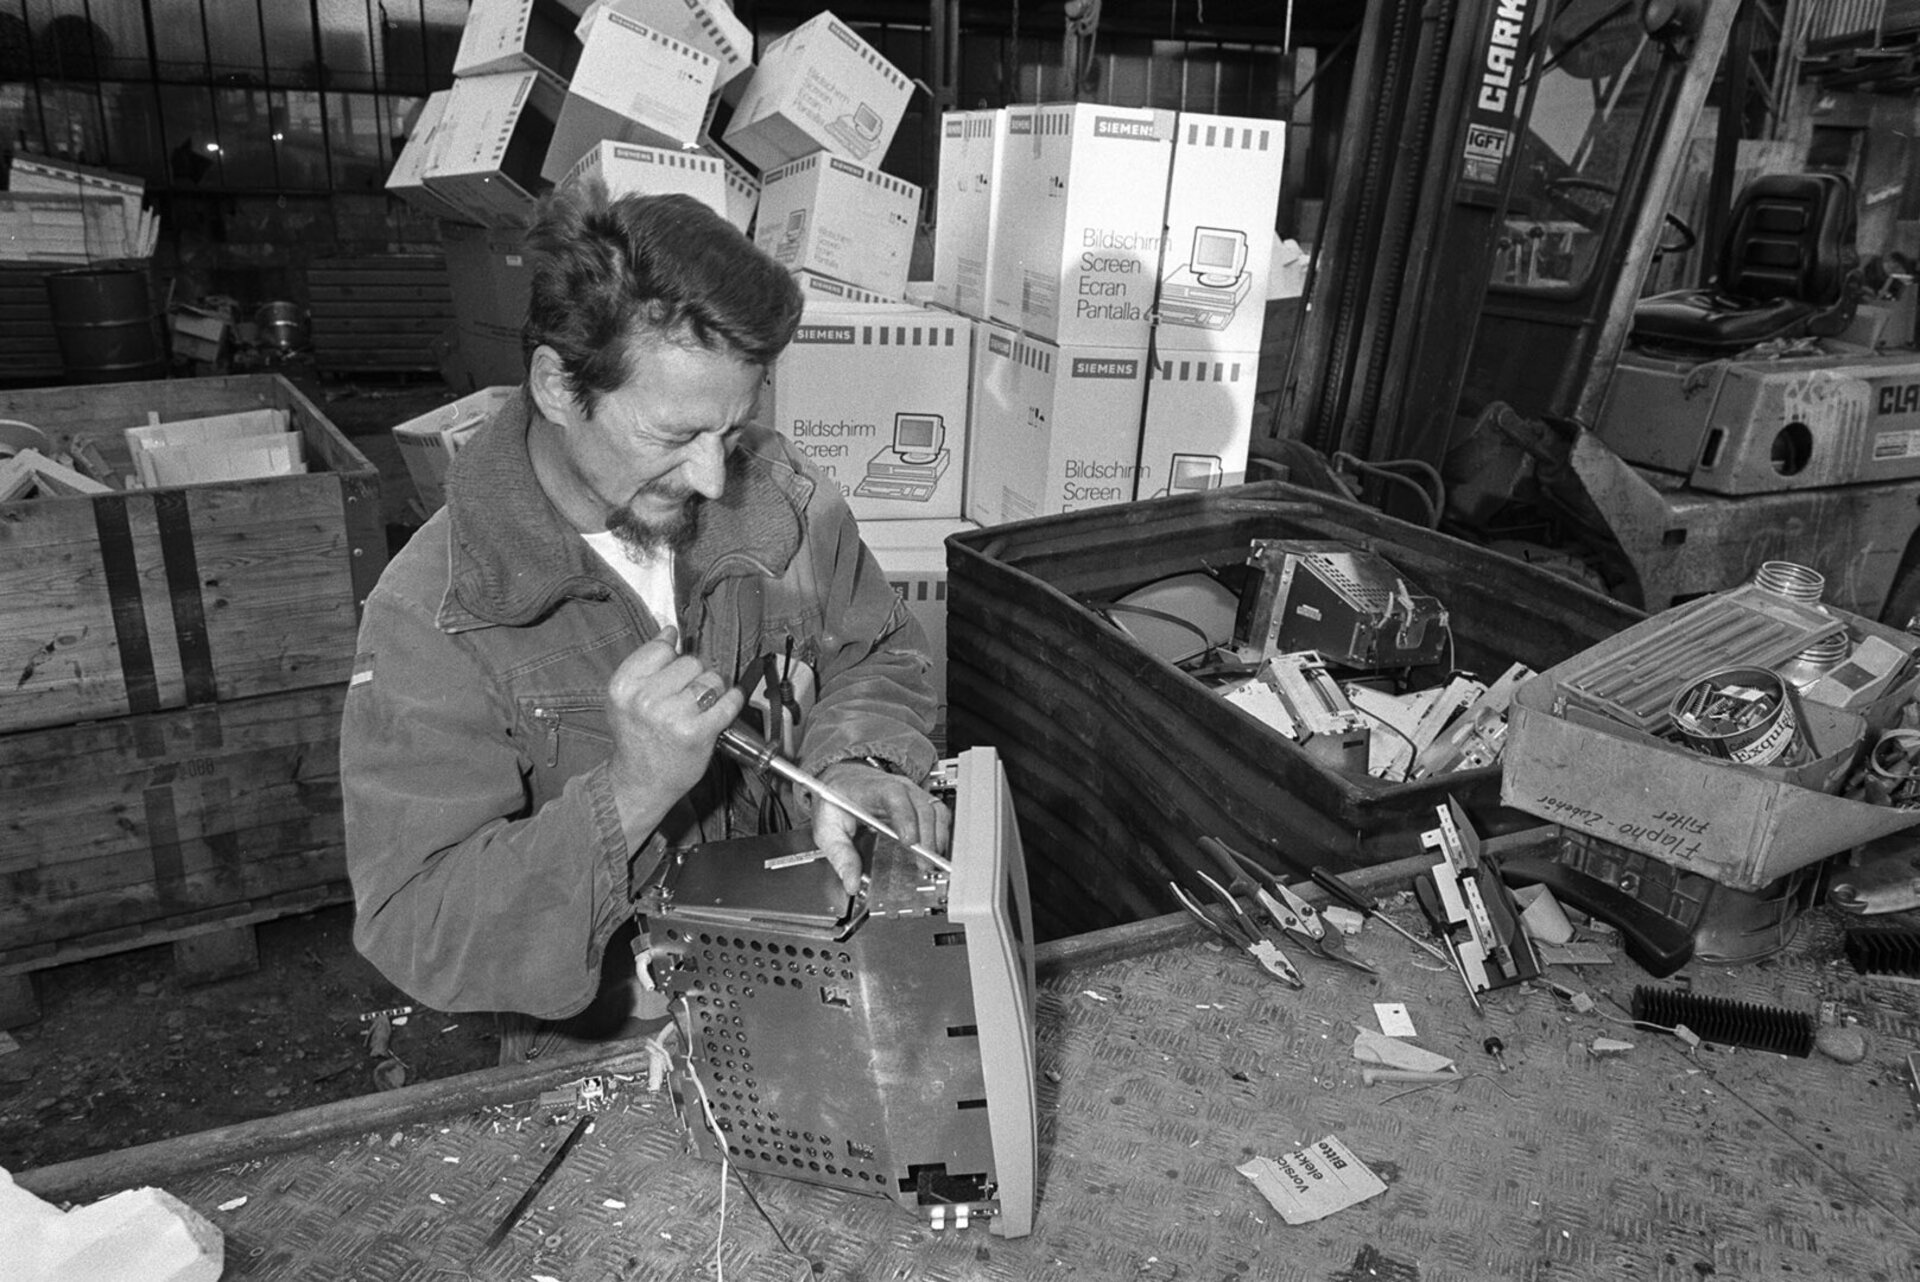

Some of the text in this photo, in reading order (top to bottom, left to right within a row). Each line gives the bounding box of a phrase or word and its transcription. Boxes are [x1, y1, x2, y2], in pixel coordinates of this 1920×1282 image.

[1478, 0, 1527, 112] CLARK
[1099, 122, 1153, 135] SIEMEN
[1469, 131, 1504, 150] IGFT
[1082, 227, 1173, 251] Bildschirm
[1080, 252, 1142, 274] Screen
[1078, 275, 1127, 297] Ecran
[1076, 299, 1141, 320] Pantalla
[796, 329, 851, 340] SIEMENS
[1076, 362, 1134, 374] SIEMENS
[793, 419, 876, 437] Bildschirm
[794, 440, 849, 457] Screen
[1064, 459, 1151, 479] Bildschirm
[1062, 482, 1121, 501] Screen
[1536, 796, 1604, 828] Zubehör
[1652, 810, 1710, 835] Filter
[1618, 823, 1702, 861] Flapho
[1318, 1142, 1349, 1170] Bitte
[1272, 1156, 1310, 1194] Vorsic
